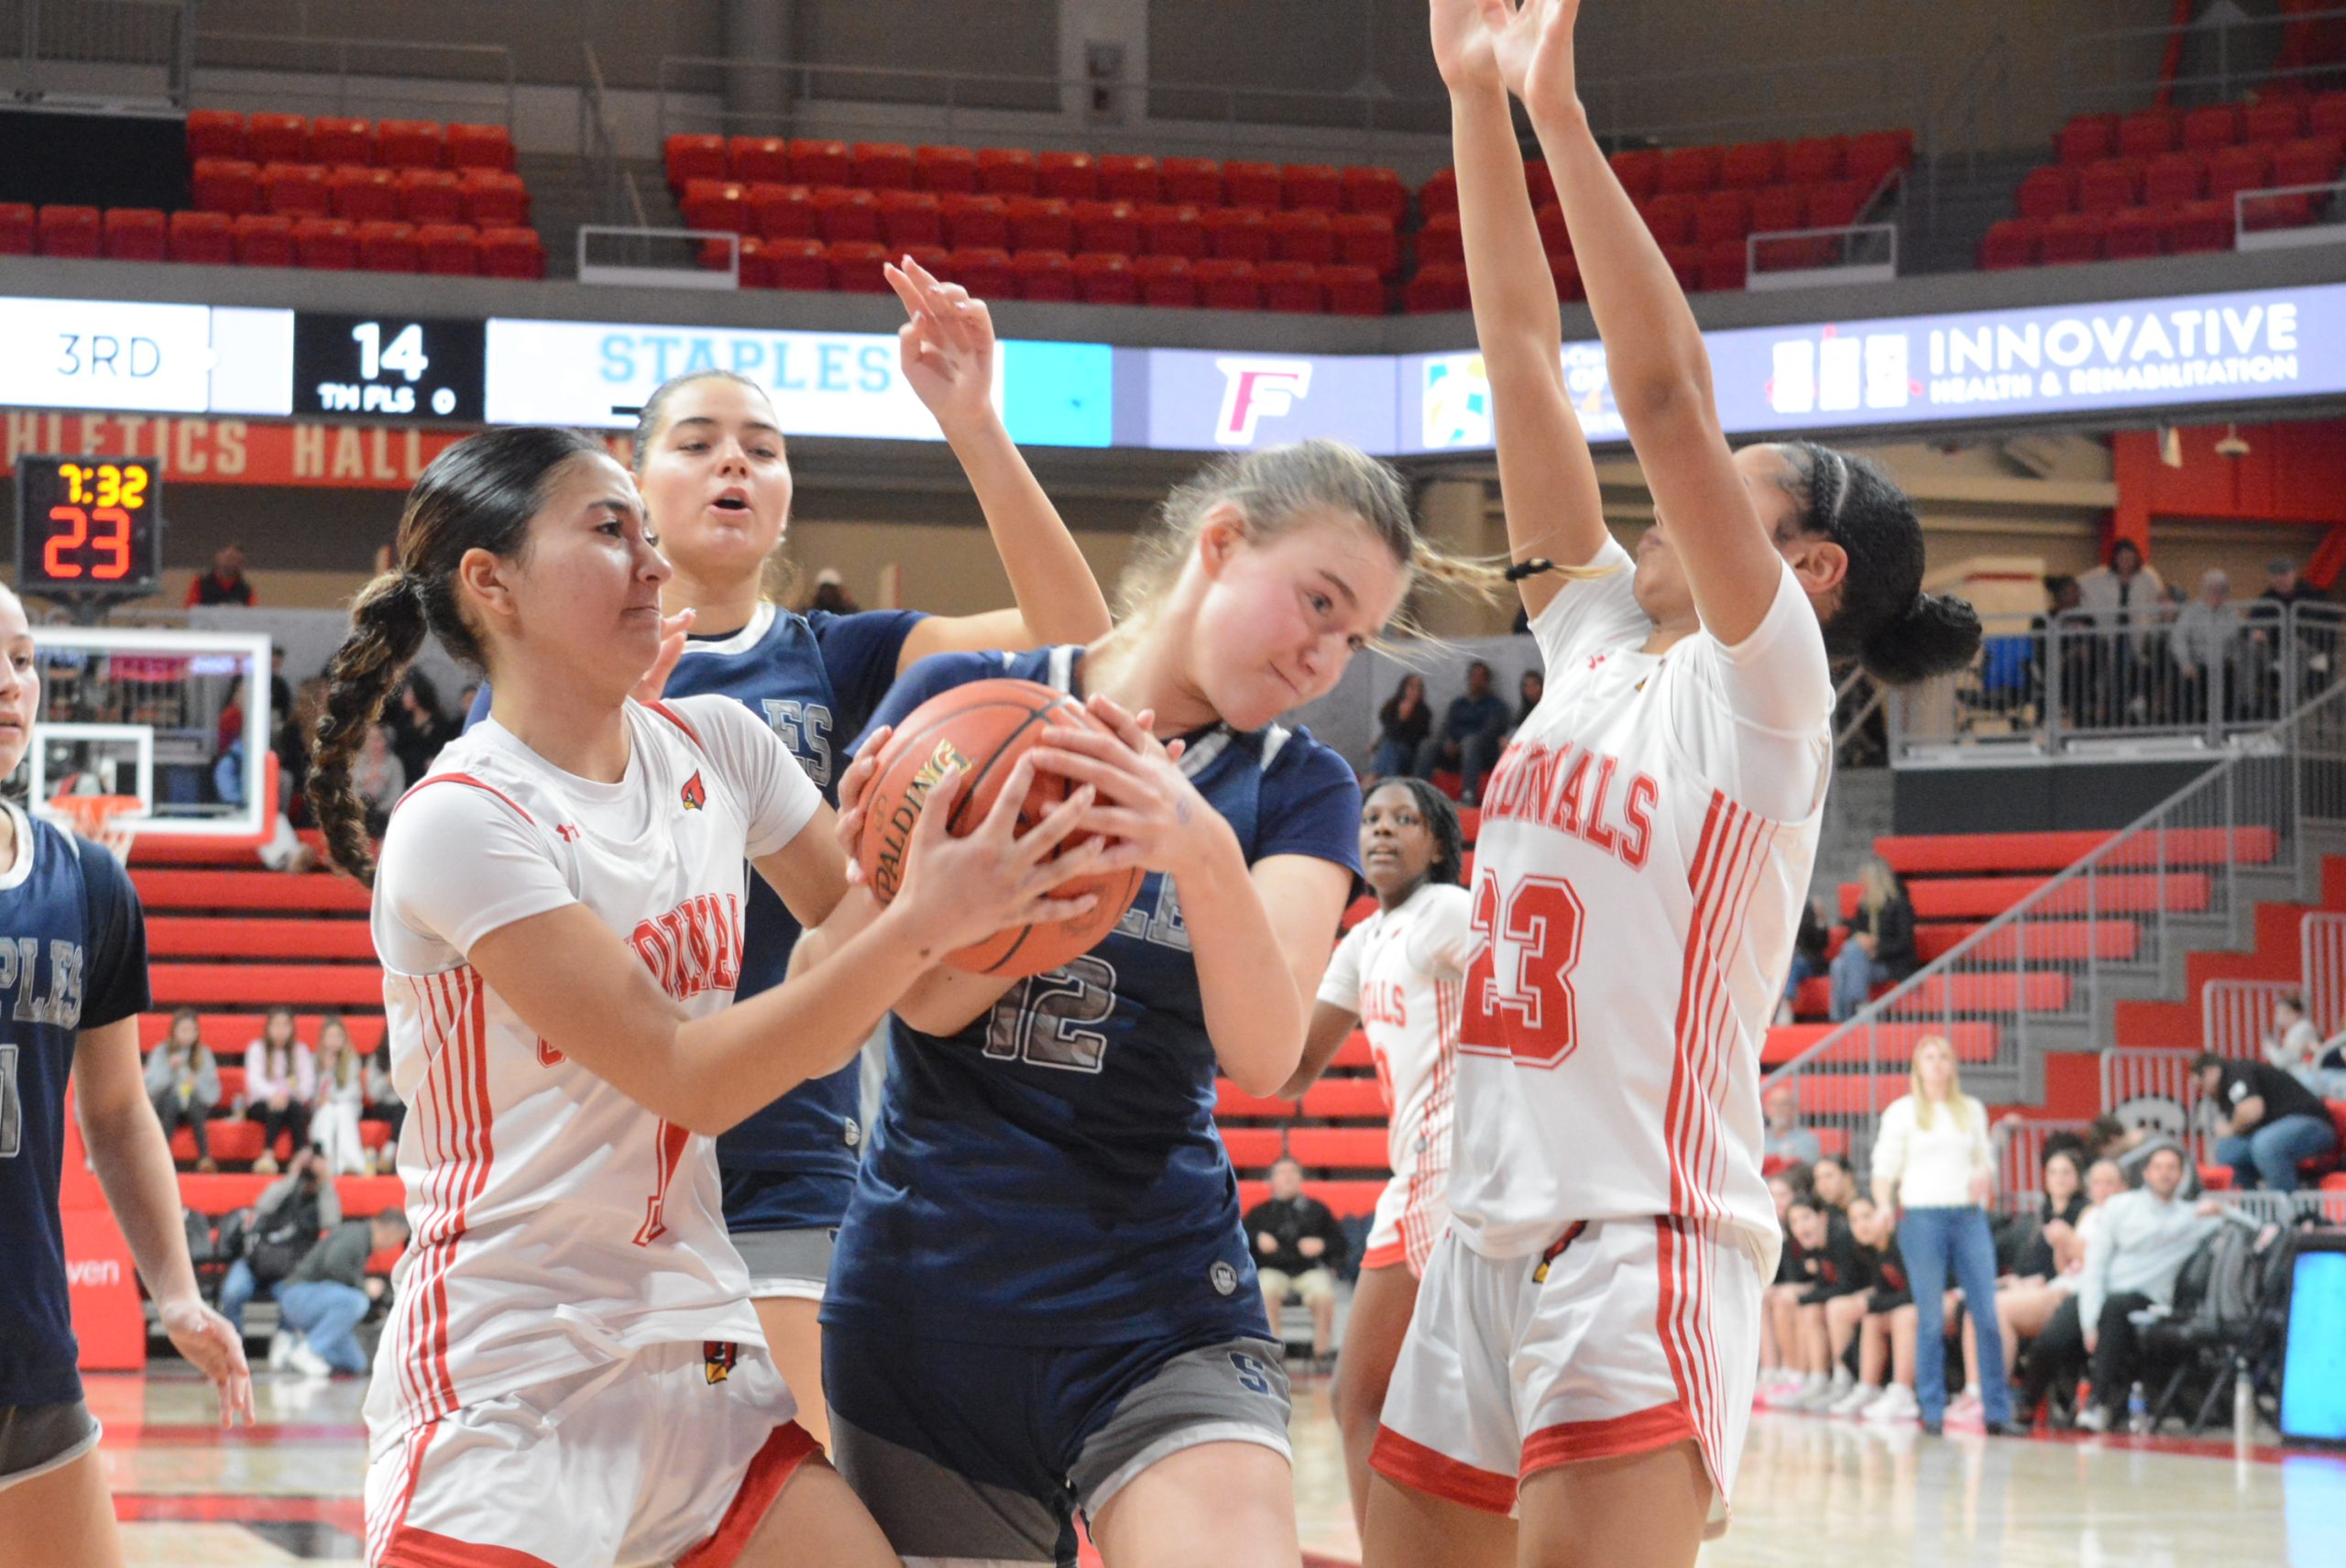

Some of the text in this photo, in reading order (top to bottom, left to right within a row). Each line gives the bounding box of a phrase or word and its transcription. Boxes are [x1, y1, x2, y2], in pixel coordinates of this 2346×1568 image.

[57, 334, 160, 378] 3RD
[352, 323, 429, 381] 14
[600, 334, 893, 392] STAPLES
[1929, 302, 2298, 376] INNOVATIVE
[317, 382, 456, 416] TM FLS 0
[1930, 354, 2298, 404] HEALTH & REHABILITATION
[293, 423, 426, 481] HALL
[59, 463, 148, 510] 7:32
[44, 506, 131, 579] 23
[1457, 867, 1585, 1071] 23
[981, 945, 1117, 1075] 12
